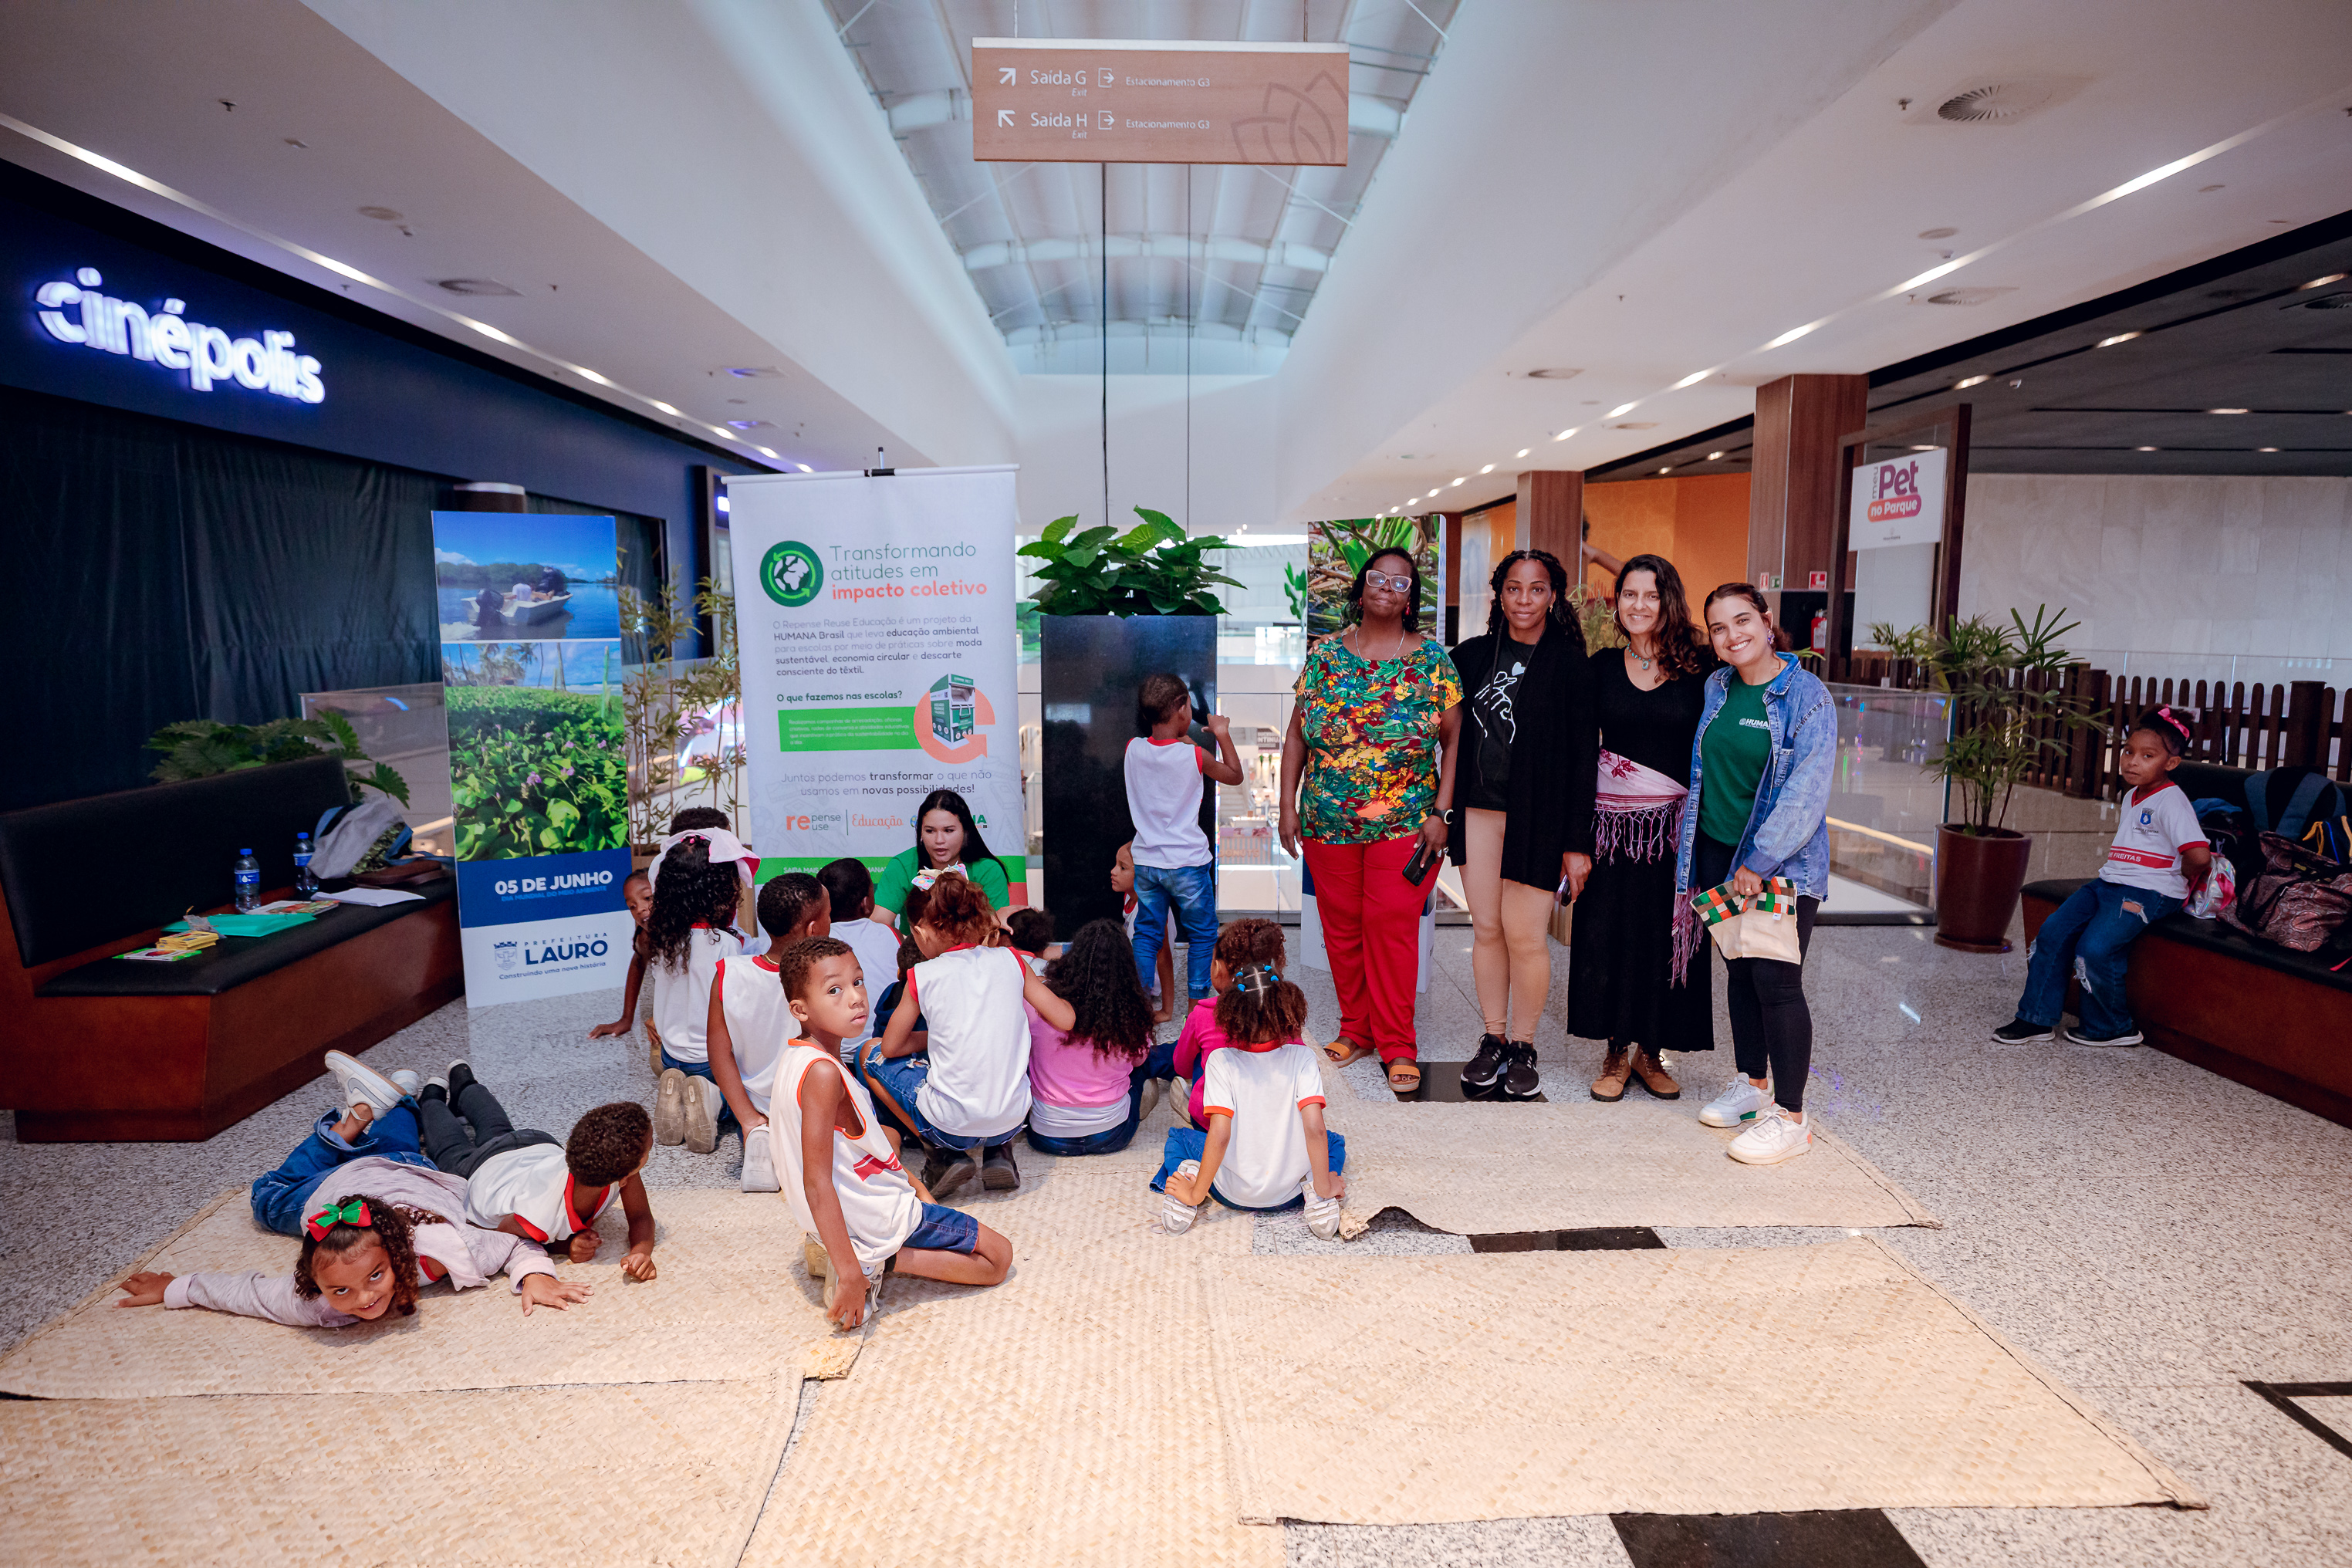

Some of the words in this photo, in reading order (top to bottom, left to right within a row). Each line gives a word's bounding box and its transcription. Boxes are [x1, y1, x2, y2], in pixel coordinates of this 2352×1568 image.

[1030, 69, 1071, 85] Saída
[1075, 70, 1086, 85] G
[1126, 77, 1196, 87] Estacionamento
[1198, 78, 1210, 87] G3
[1071, 88, 1087, 97] Exit
[1030, 112, 1071, 127] Saída
[1076, 113, 1087, 127] H
[1126, 119, 1196, 129] Estacionamento
[1198, 120, 1210, 130] G3
[1072, 130, 1087, 139] Exit
[36, 267, 325, 404] cinépolis
[1879, 461, 1919, 500] Pet
[1871, 505, 1882, 517] no
[1884, 500, 1917, 515] Parque
[830, 541, 976, 561] Transformando
[831, 563, 904, 580] atitudes
[911, 566, 938, 577] em
[832, 583, 904, 603] impacto
[911, 580, 987, 596] coletivo
[773, 621, 781, 629] O
[783, 620, 821, 630] Repense
[824, 619, 850, 628] Reuse
[853, 617, 896, 628] Educação
[899, 617, 904, 625] é
[923, 615, 956, 626] projeto
[960, 615, 972, 623] da
[774, 632, 816, 641] HUMANA
[819, 630, 845, 639] Brasil
[847, 631, 863, 640] que
[865, 630, 884, 638] leva
[886, 628, 930, 638] educação
[932, 626, 979, 635] ambiental
[775, 645, 797, 655] para
[798, 643, 831, 652] escolas
[834, 644, 848, 653] por
[852, 641, 872, 651] meio
[875, 641, 886, 650] de
[889, 640, 924, 650] práticas
[928, 639, 953, 648] sobre
[956, 638, 982, 647] moda
[833, 653, 874, 662] economia
[877, 652, 909, 661] circular
[921, 651, 961, 660] descarte
[777, 666, 824, 676] consciente
[826, 666, 837, 675] do
[839, 665, 864, 674] têxtil.
[777, 694, 784, 702] O
[786, 694, 803, 704] que
[806, 692, 843, 701] fazemos
[864, 690, 902, 700] escolas?
[1745, 719, 1768, 727] HUMA
[782, 773, 815, 783] Juntos
[818, 772, 866, 784] podemos
[869, 771, 933, 781] transformar
[947, 772, 967, 782] que
[971, 770, 992, 779] não
[786, 815, 809, 831] re
[812, 814, 841, 823] pense
[852, 814, 903, 829] Educação
[2113, 852, 2141, 862] FREITAS
[495, 880, 519, 895] 05
[522, 877, 547, 892] DE
[550, 870, 613, 890] JUNHO
[576, 885, 607, 894] AMBIENTE
[524, 932, 607, 946] PREFEITURA
[525, 940, 608, 965] LAURO
[499, 969, 542, 980] Construindo
